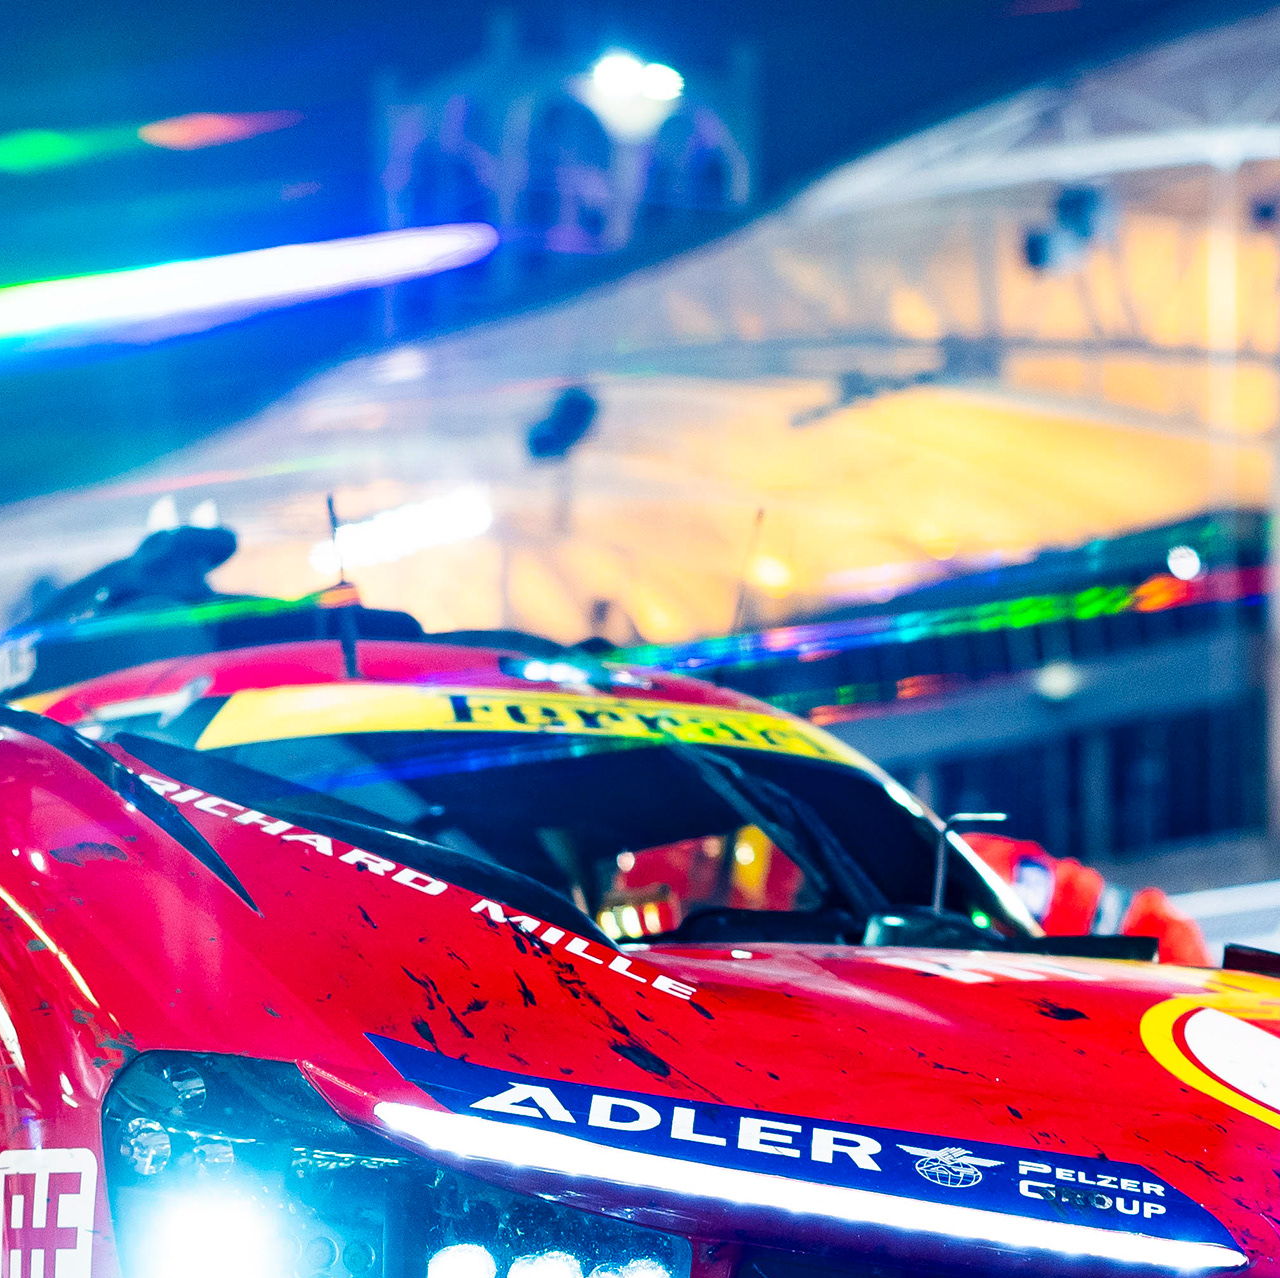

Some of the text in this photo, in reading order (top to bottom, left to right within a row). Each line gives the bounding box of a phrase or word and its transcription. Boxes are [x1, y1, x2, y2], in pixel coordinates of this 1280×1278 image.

[137, 773, 697, 1001] RICHARD MILLE
[469, 1081, 882, 1172] ADLER
[1018, 1160, 1165, 1197] PELZER
